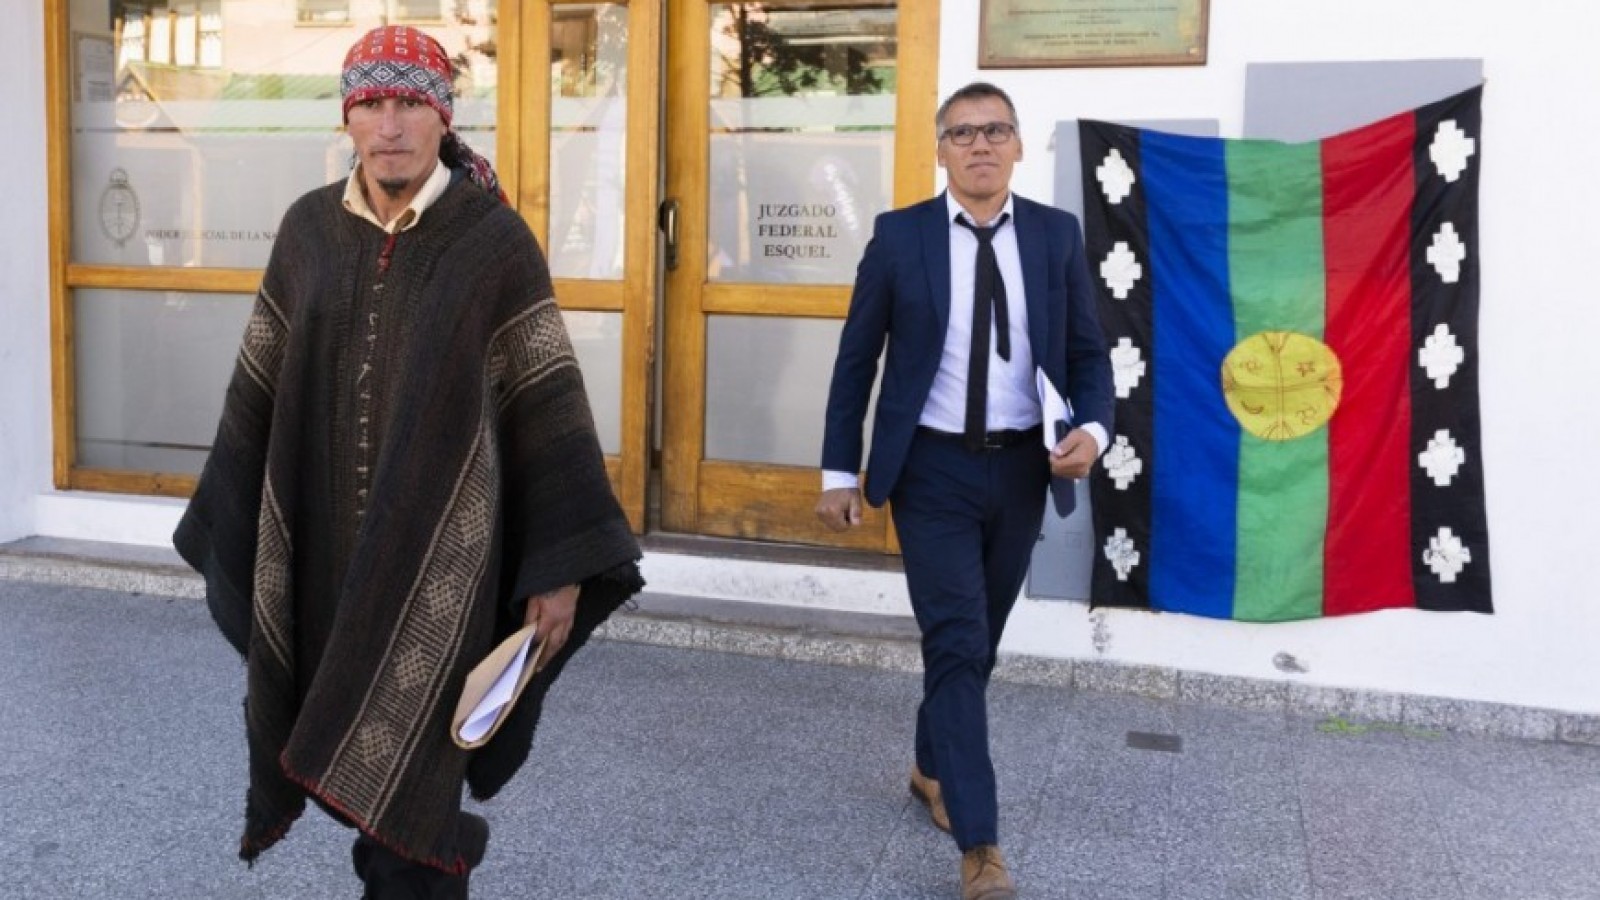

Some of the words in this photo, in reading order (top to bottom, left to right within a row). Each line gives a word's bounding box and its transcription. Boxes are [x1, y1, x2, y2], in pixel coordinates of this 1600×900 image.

[757, 203, 836, 220] JUZGADO
[230, 230, 247, 240] DE
[247, 230, 260, 240] LA
[758, 224, 838, 238] FEDERAL
[764, 244, 832, 260] ESQUEL
